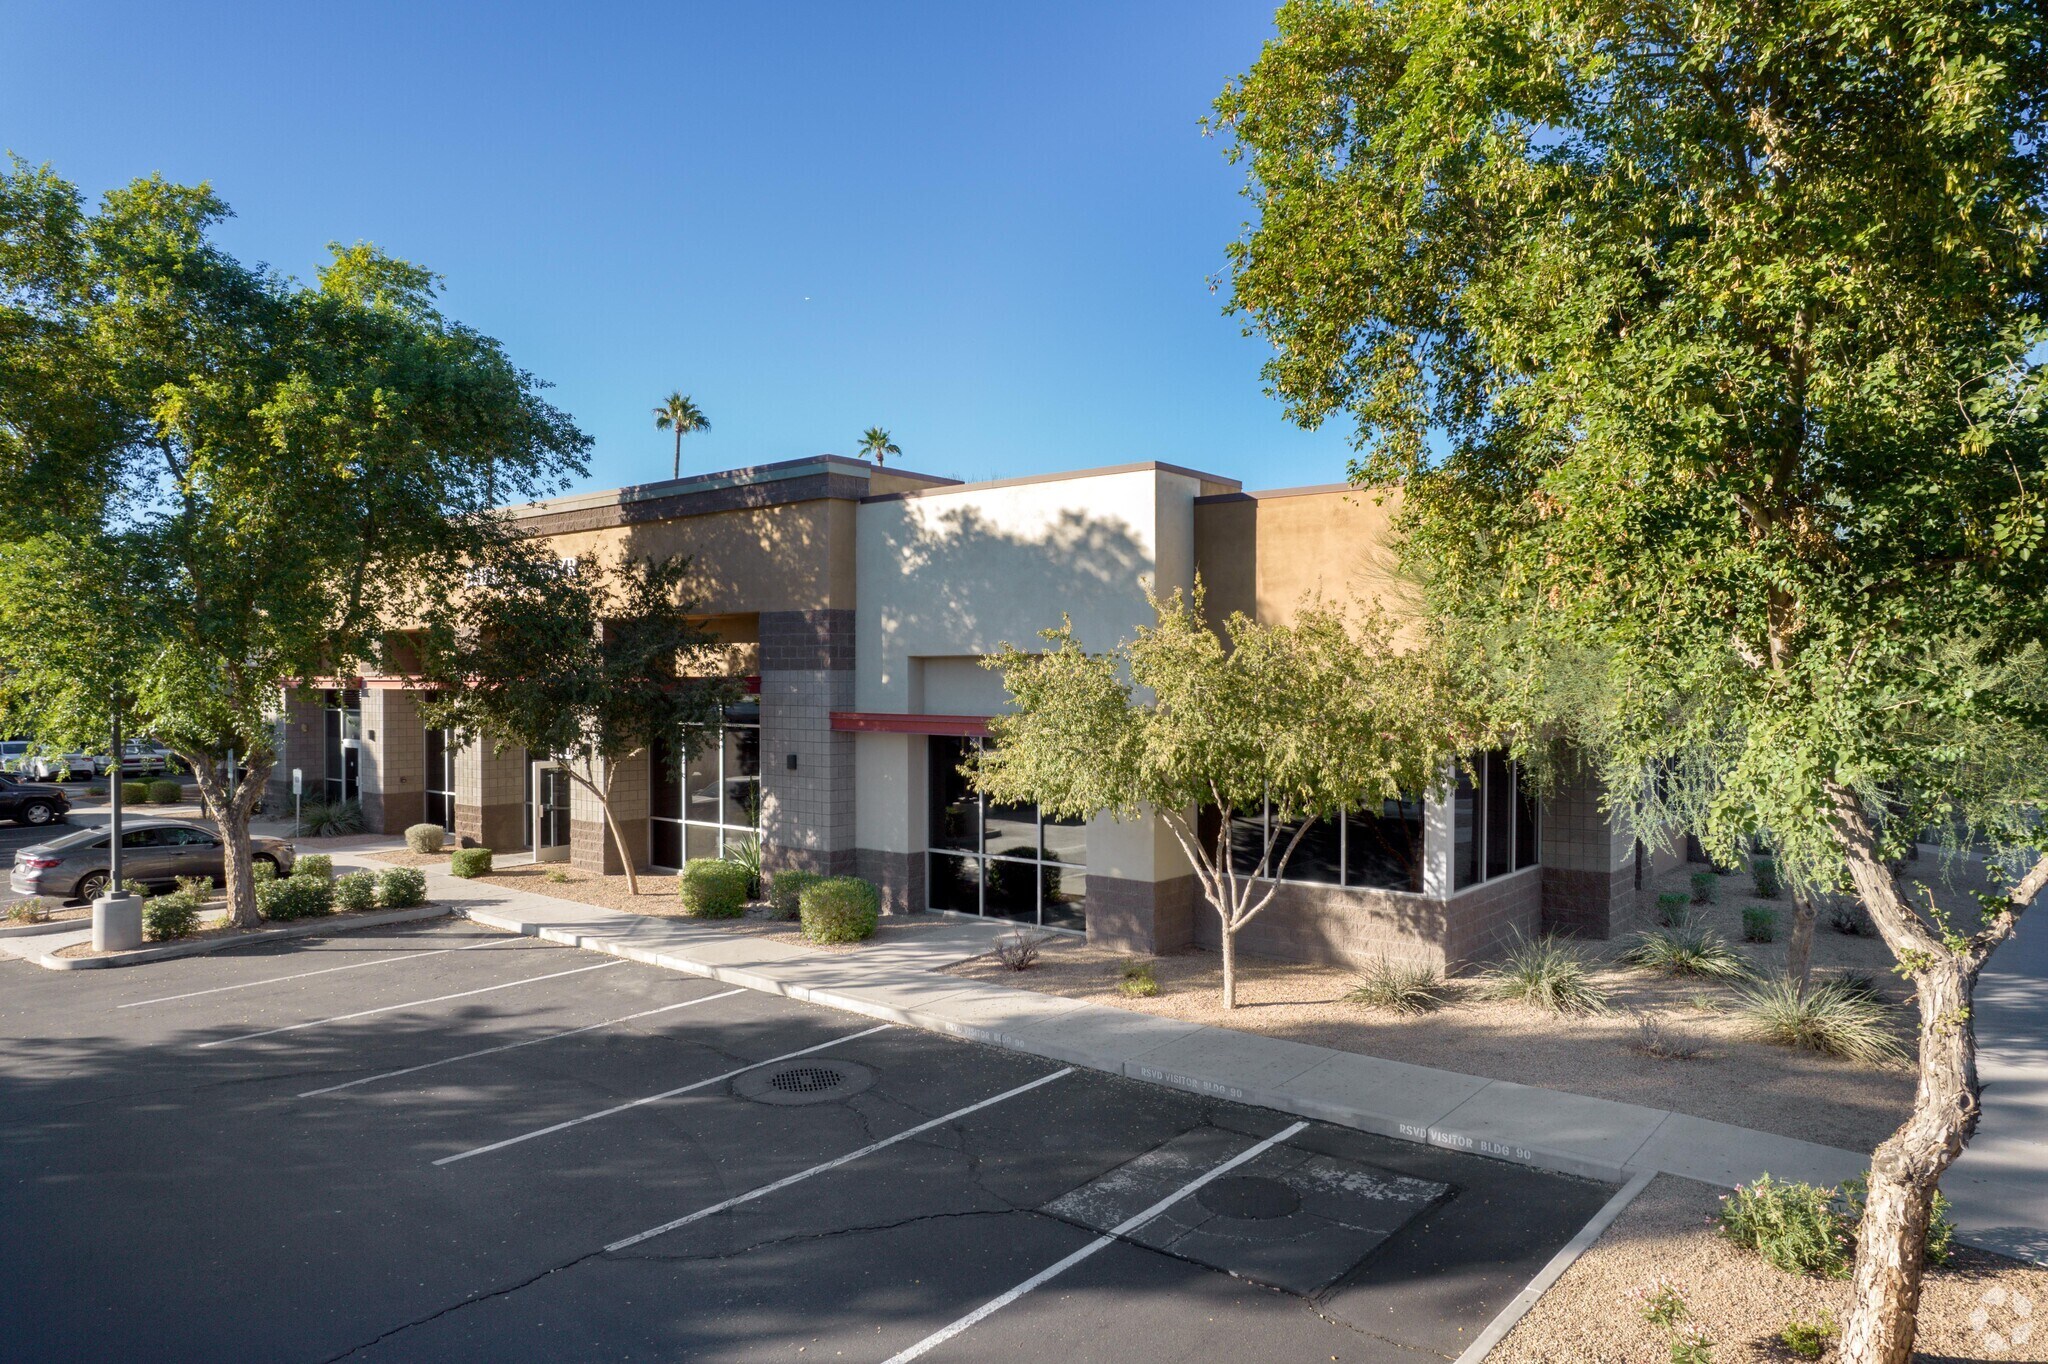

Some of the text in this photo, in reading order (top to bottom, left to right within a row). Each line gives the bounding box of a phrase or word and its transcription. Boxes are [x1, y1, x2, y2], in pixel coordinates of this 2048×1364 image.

[965, 1027, 990, 1039] VISITOR
[1141, 1067, 1242, 1098] RSVD VISITOR BLDG 90
[1400, 1124, 1531, 1160] RSVD VISITOR BLDG 90
